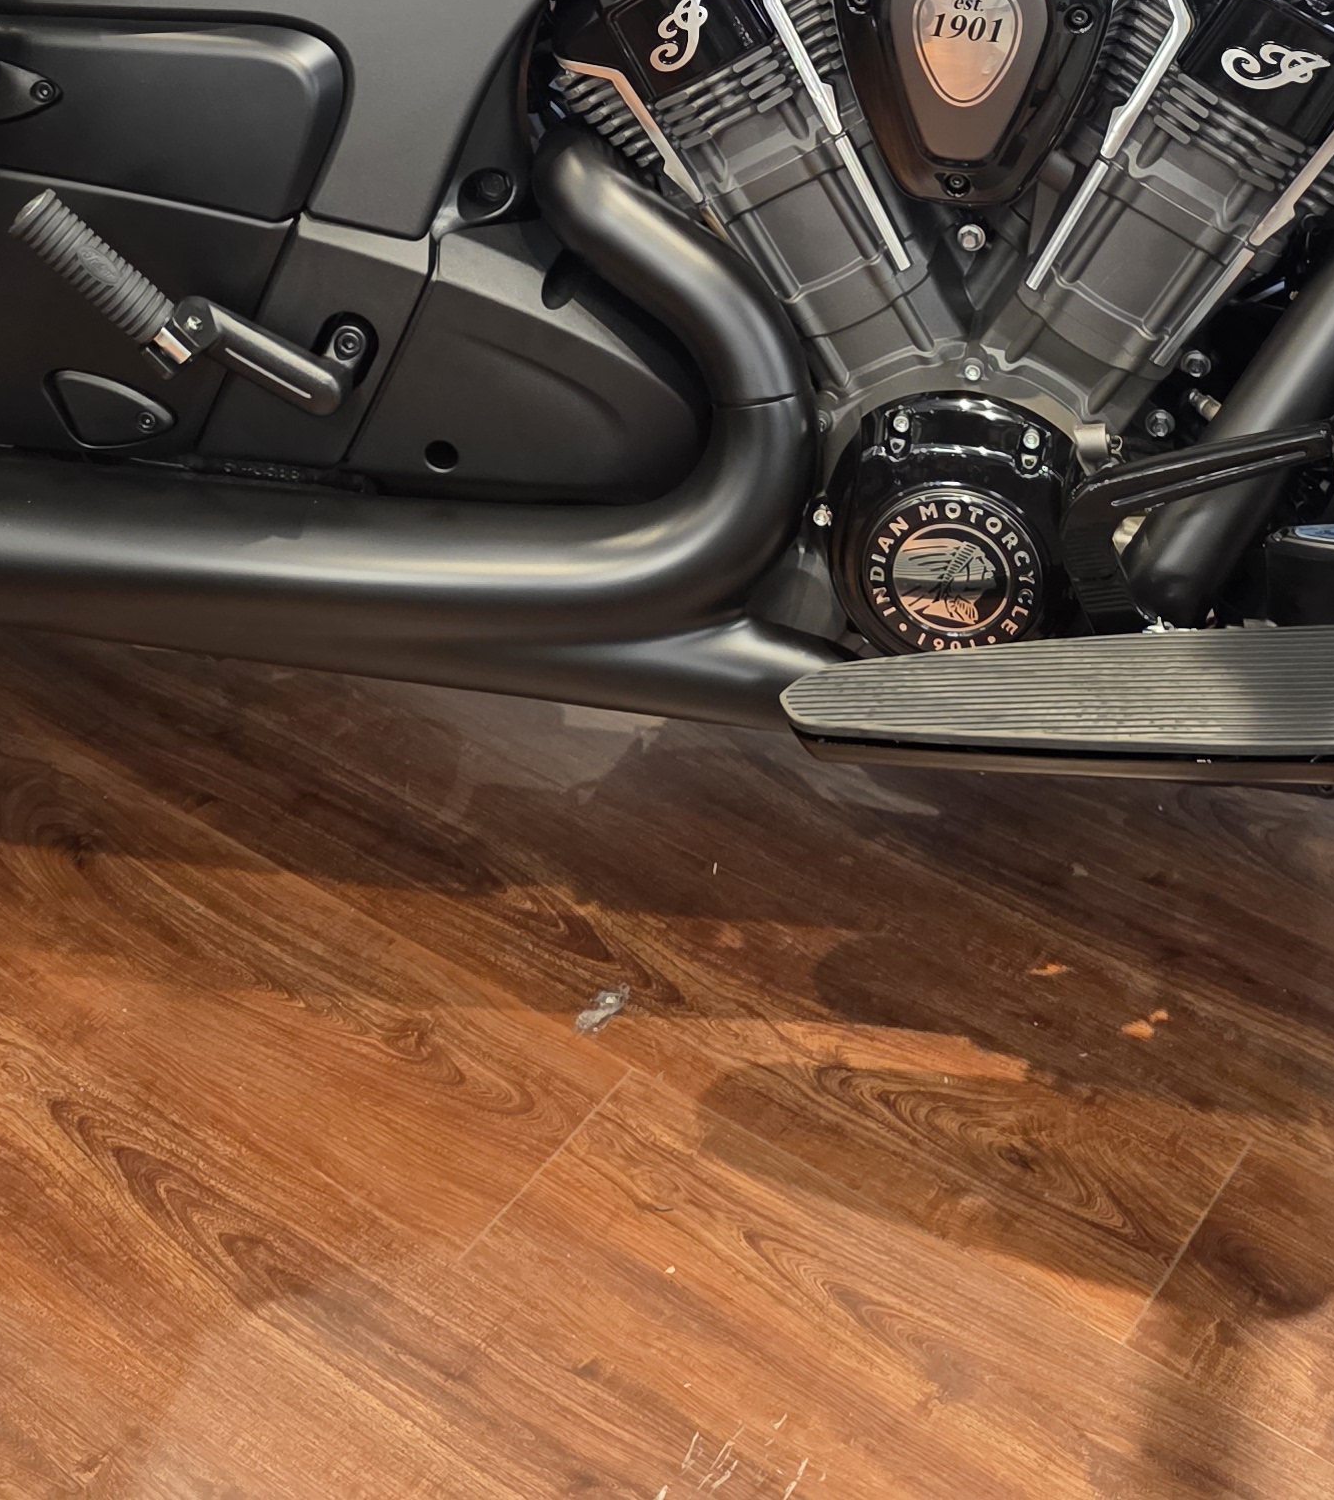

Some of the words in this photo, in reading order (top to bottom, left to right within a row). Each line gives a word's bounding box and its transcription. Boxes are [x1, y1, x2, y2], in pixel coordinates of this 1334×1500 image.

[930, 13, 1003, 43] 1901
[869, 515, 910, 617] INDIAN
[918, 502, 1036, 636] MOTORCYCLE
